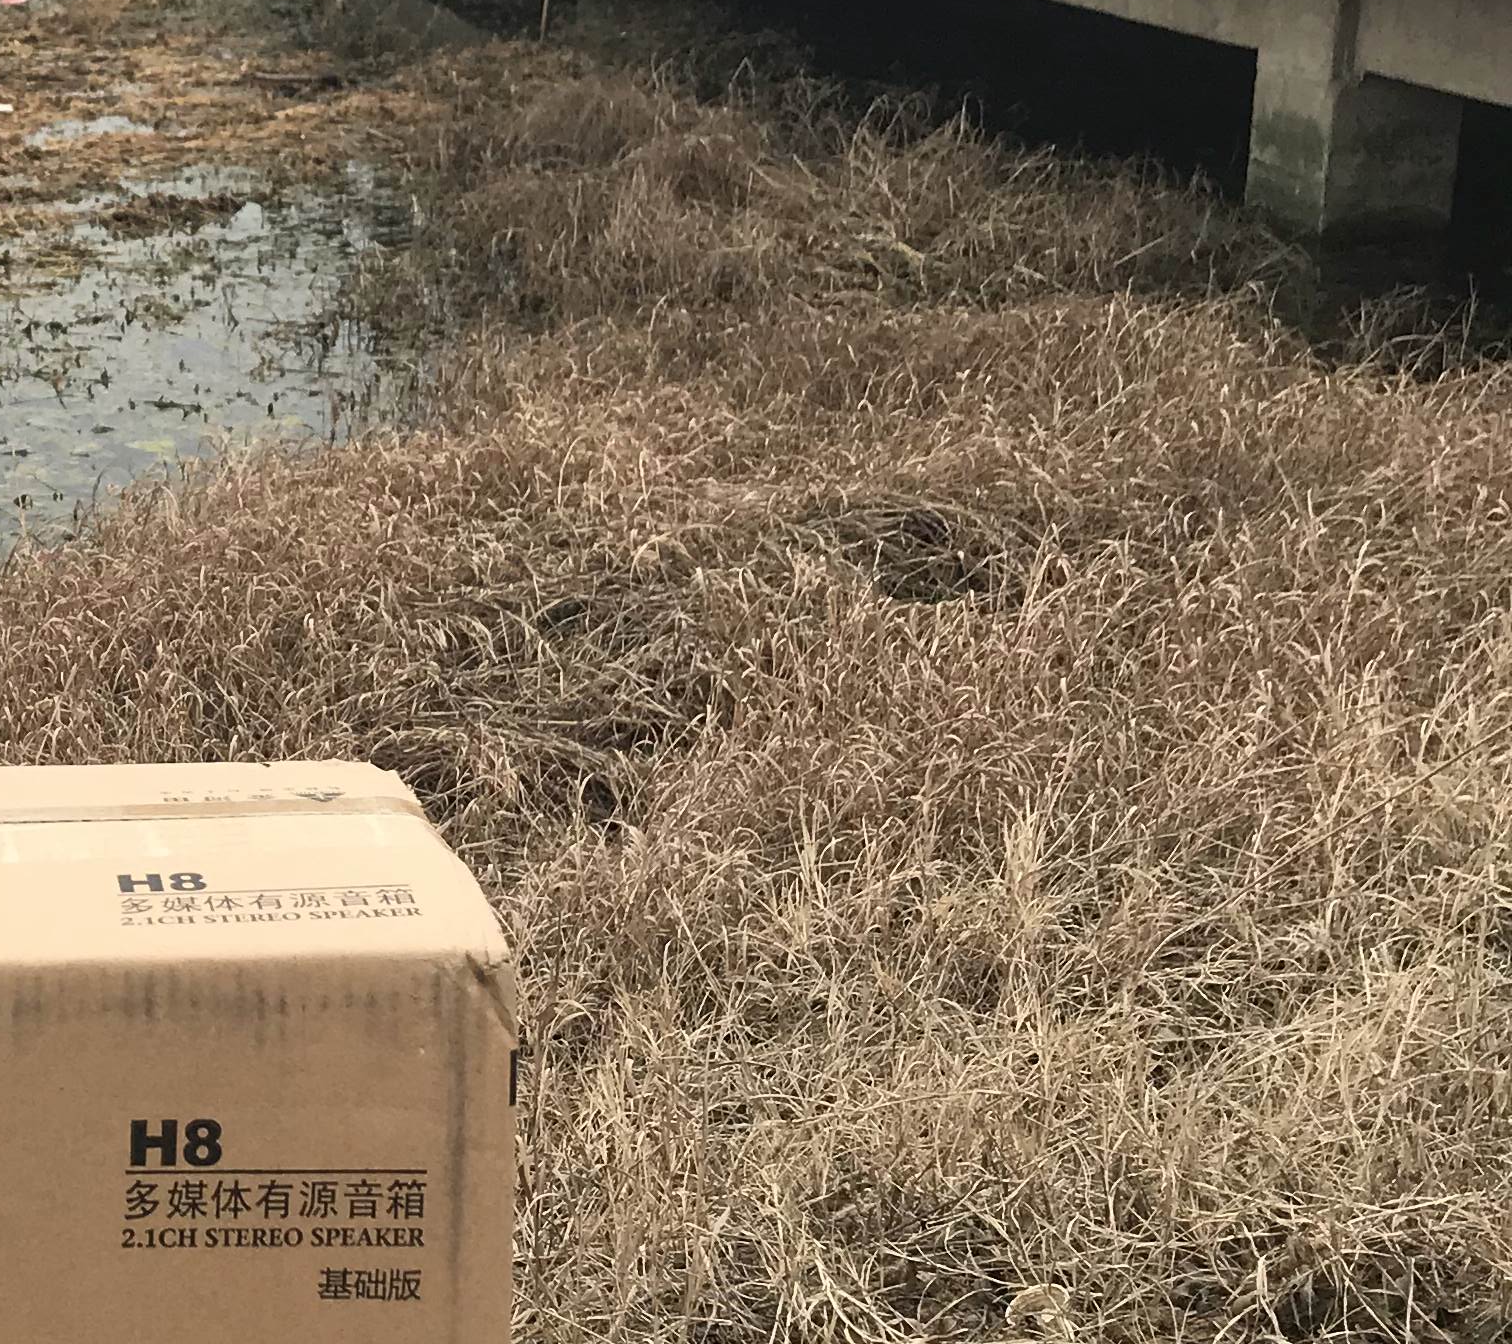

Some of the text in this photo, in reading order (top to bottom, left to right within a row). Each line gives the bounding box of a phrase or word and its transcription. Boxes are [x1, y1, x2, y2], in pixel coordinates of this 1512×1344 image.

[116, 872, 208, 893] H8
[120, 887, 417, 915] 多媒体有源音箱
[119, 906, 424, 927] 2.1CH STEREO SPEAKER
[129, 1118, 223, 1168] H8
[123, 1178, 427, 1221] 多媒体有源音箱
[120, 1227, 426, 1249] 2.1CH STEREO SPEAKER
[317, 1266, 423, 1302] 基础版
